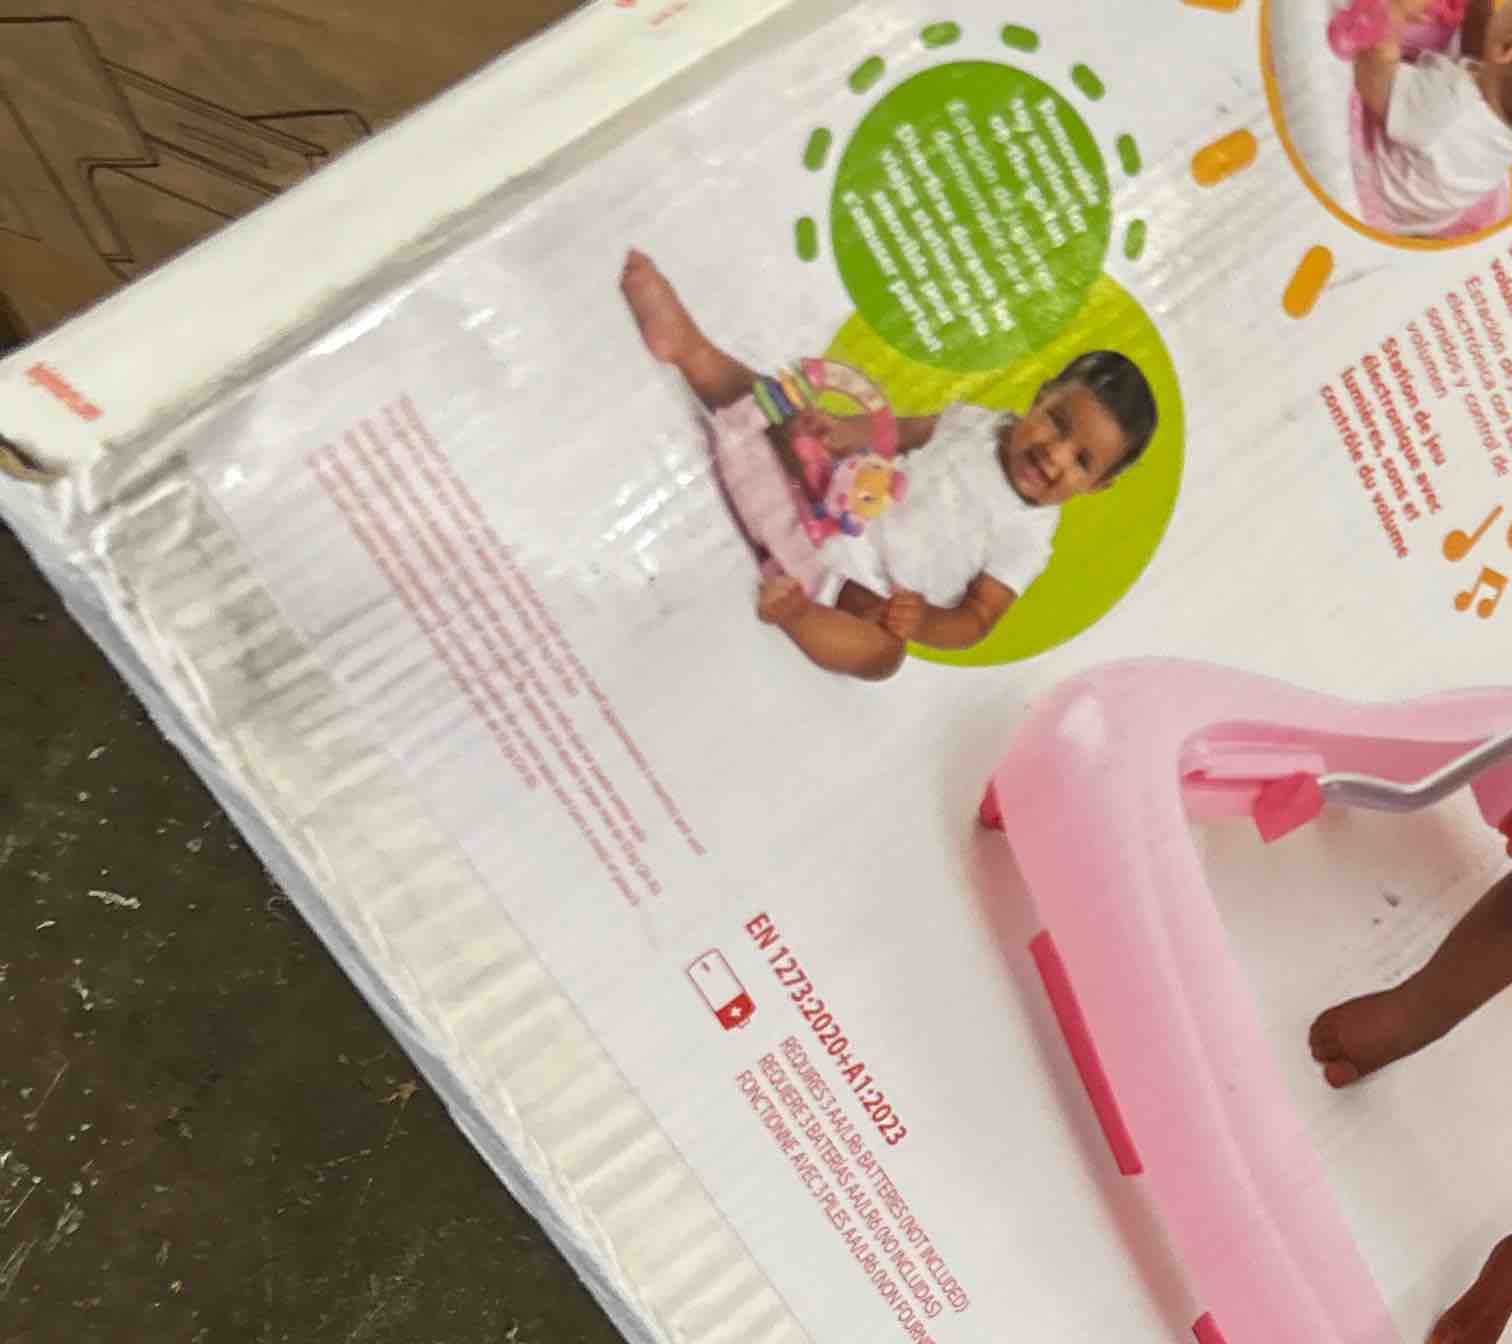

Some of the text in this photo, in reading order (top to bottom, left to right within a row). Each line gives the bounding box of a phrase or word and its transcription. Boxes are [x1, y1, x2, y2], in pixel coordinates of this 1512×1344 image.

[1381, 337, 1446, 467] Station de jeu
[746, 912, 907, 1146] EN 1273:2020+A1:2023
[779, 1035, 830, 1102] REQUIRES
[819, 1096, 837, 1111] 3
[856, 1150, 909, 1220] BATTERIES
[898, 1215, 930, 1248] (NOT
[919, 1245, 970, 1312] INCLUDED)
